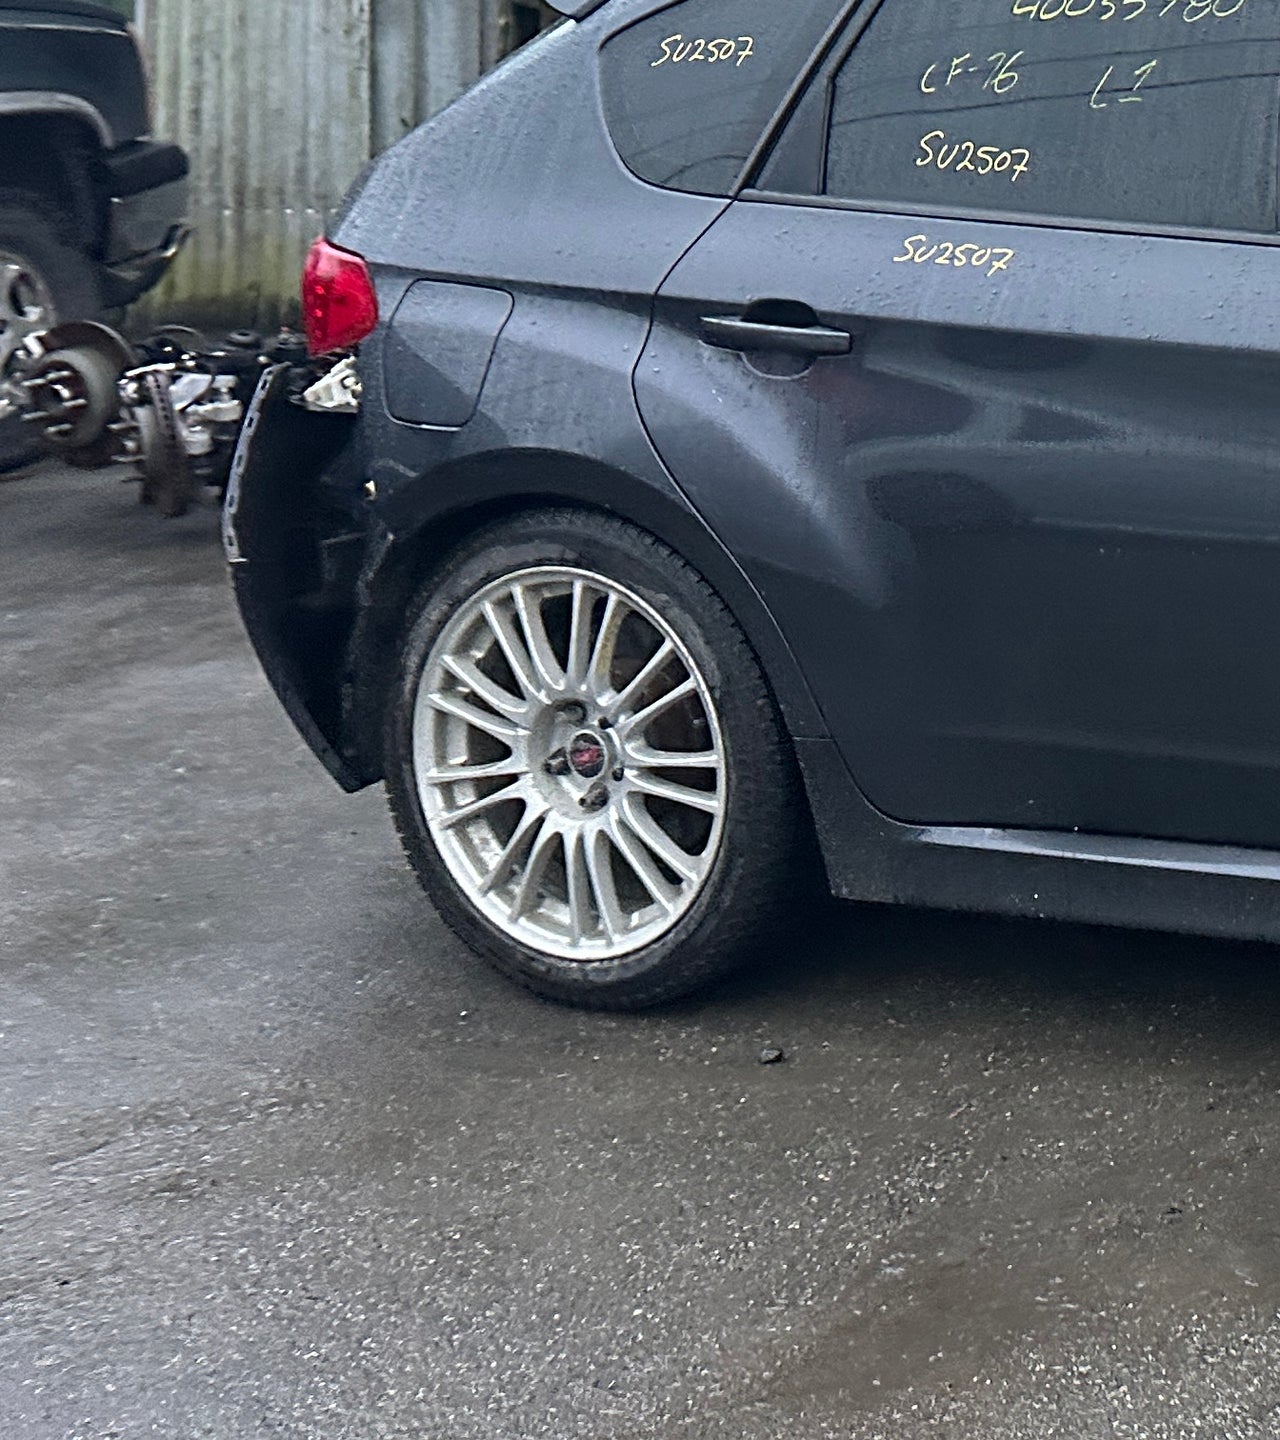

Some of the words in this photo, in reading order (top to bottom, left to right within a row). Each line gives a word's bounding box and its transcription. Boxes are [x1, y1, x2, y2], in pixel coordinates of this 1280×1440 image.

[650, 33, 754, 68] SU2507
[915, 129, 1031, 182] SU2507
[892, 234, 1015, 278] SU2507
